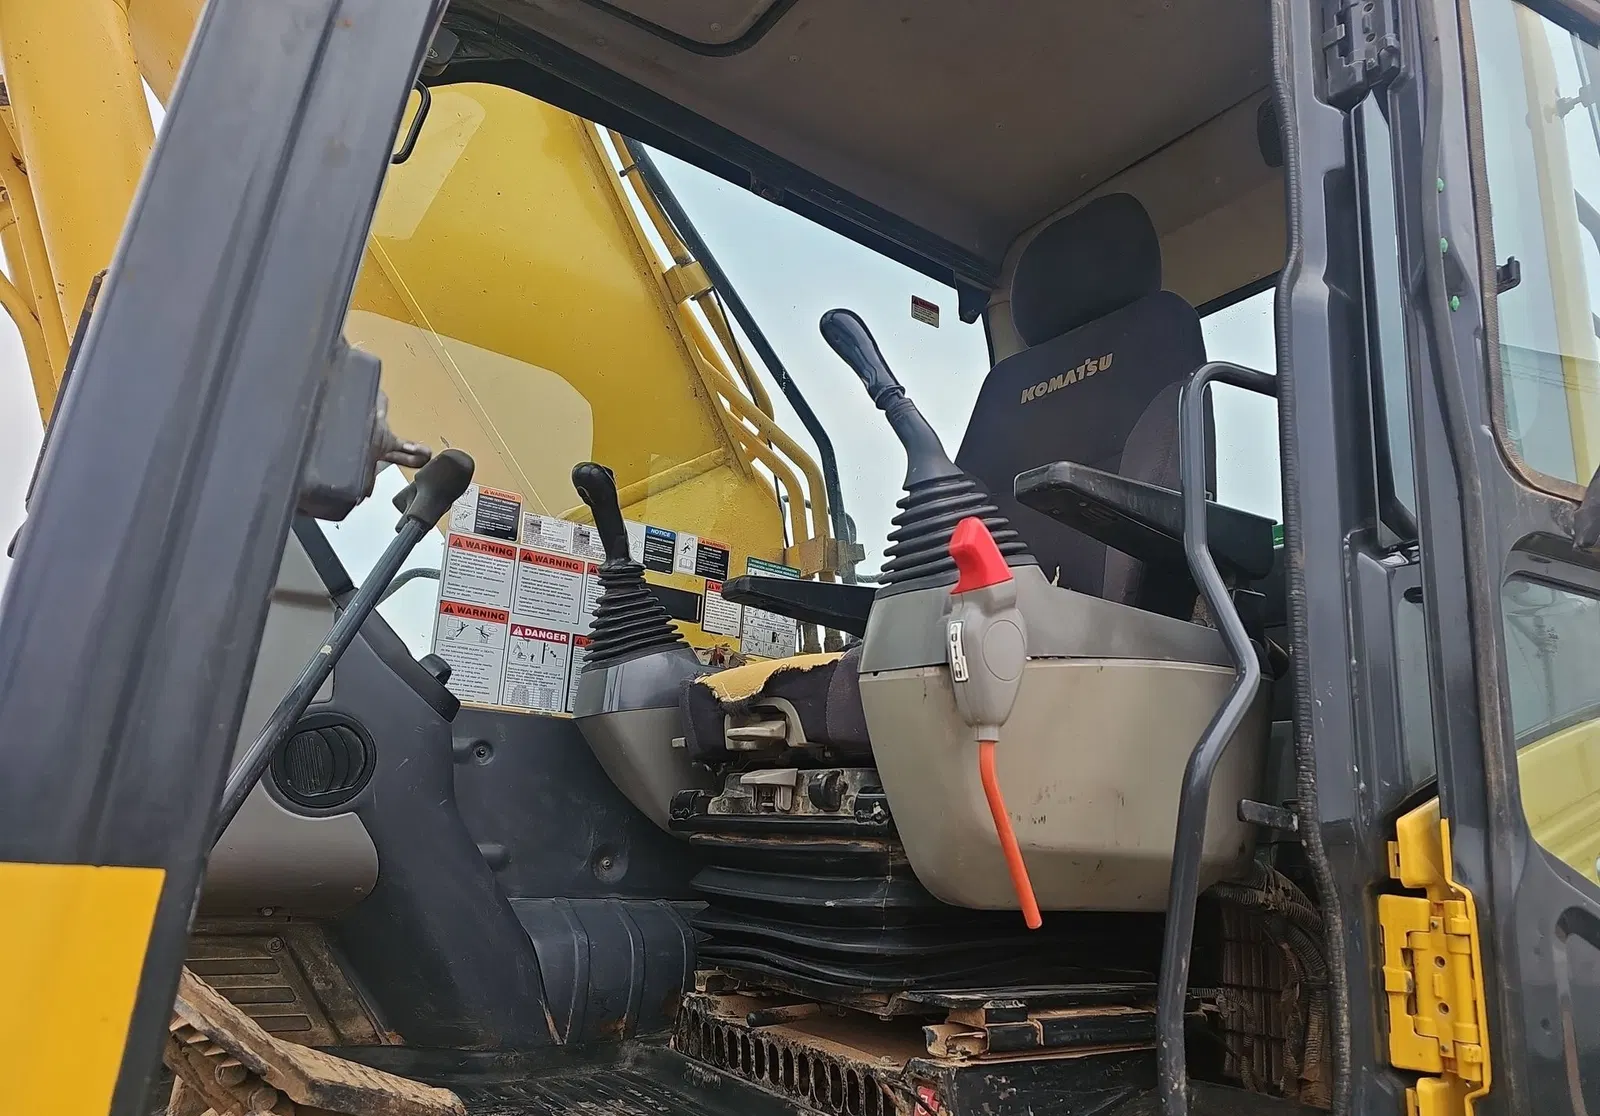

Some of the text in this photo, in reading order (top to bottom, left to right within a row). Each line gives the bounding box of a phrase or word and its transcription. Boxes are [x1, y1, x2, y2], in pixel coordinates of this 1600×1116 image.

[1020, 353, 1113, 404] KOMATSU
[490, 491, 515, 500] WARNING
[651, 529, 671, 538] NOTICE
[465, 541, 513, 557] WARNING
[534, 555, 579, 570] WARNING
[457, 607, 505, 621] WARNING
[524, 628, 567, 642] DANGER
